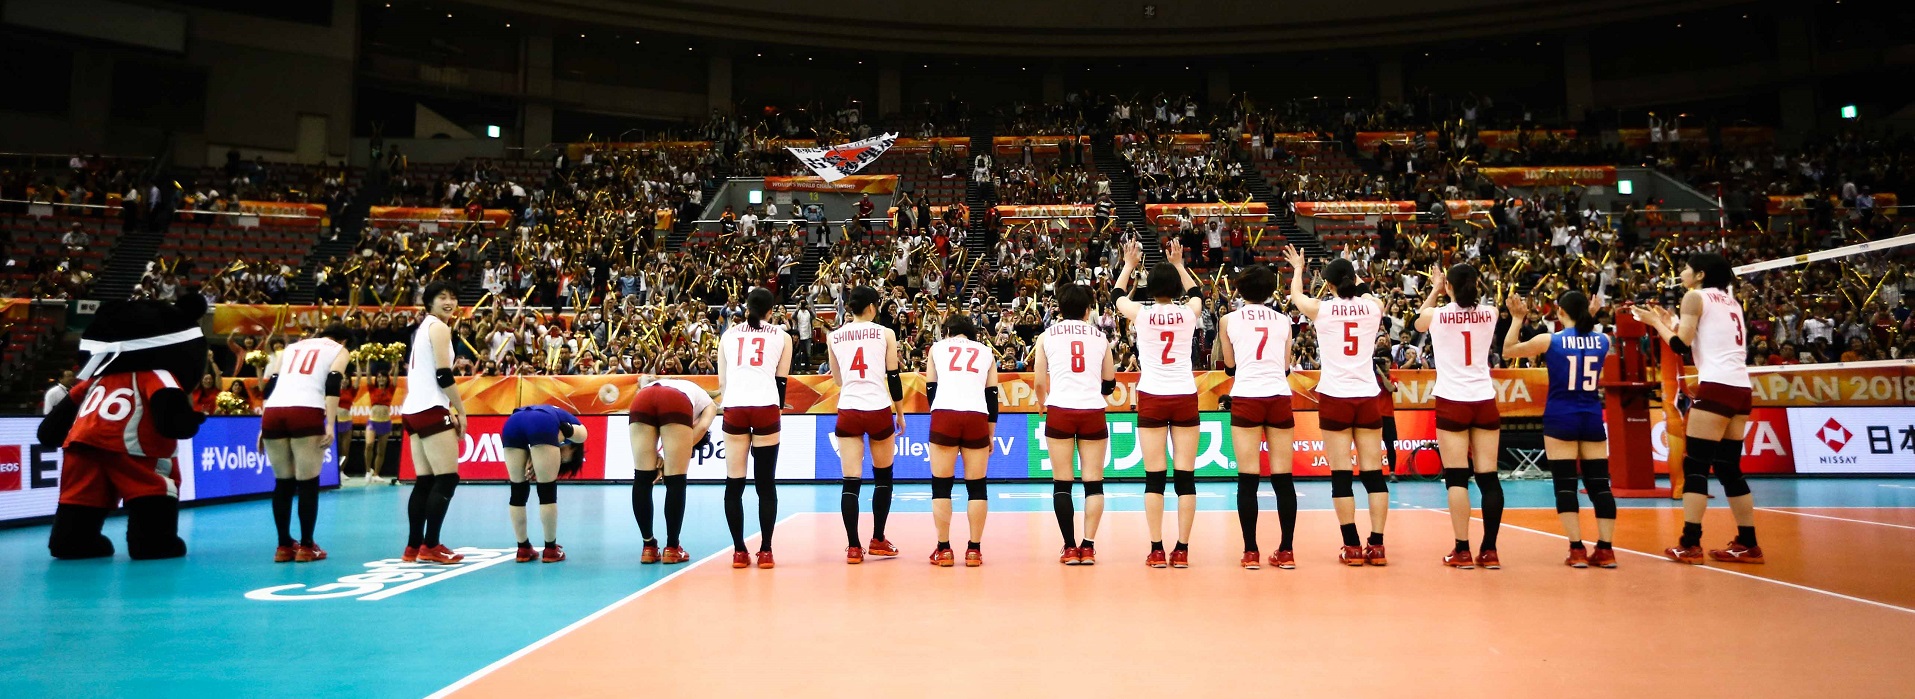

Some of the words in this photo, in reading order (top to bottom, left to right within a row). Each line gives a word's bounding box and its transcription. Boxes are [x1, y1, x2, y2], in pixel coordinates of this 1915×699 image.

[1149, 312, 1184, 325] KOGA
[1241, 310, 1278, 321] ISHII
[1331, 304, 1371, 316] ARAKI
[1439, 311, 1492, 324] NAGAOKA
[833, 328, 881, 344] SHINNABE
[1050, 325, 1101, 337] UCHISETO
[1343, 322, 1358, 356] 5
[1562, 336, 1602, 349] INOUE
[1730, 312, 1743, 346] 3
[737, 337, 765, 366] 13
[1071, 341, 1085, 373] 8
[1160, 331, 1176, 364] 2
[1255, 327, 1268, 360] 7
[1461, 331, 1472, 366] 1
[288, 349, 320, 374] 10
[850, 346, 869, 378] 4
[949, 346, 979, 373] 22
[1566, 355, 1599, 391] 15
[1851, 375, 1915, 402] 2018
[1819, 456, 1858, 464] NISSAY
